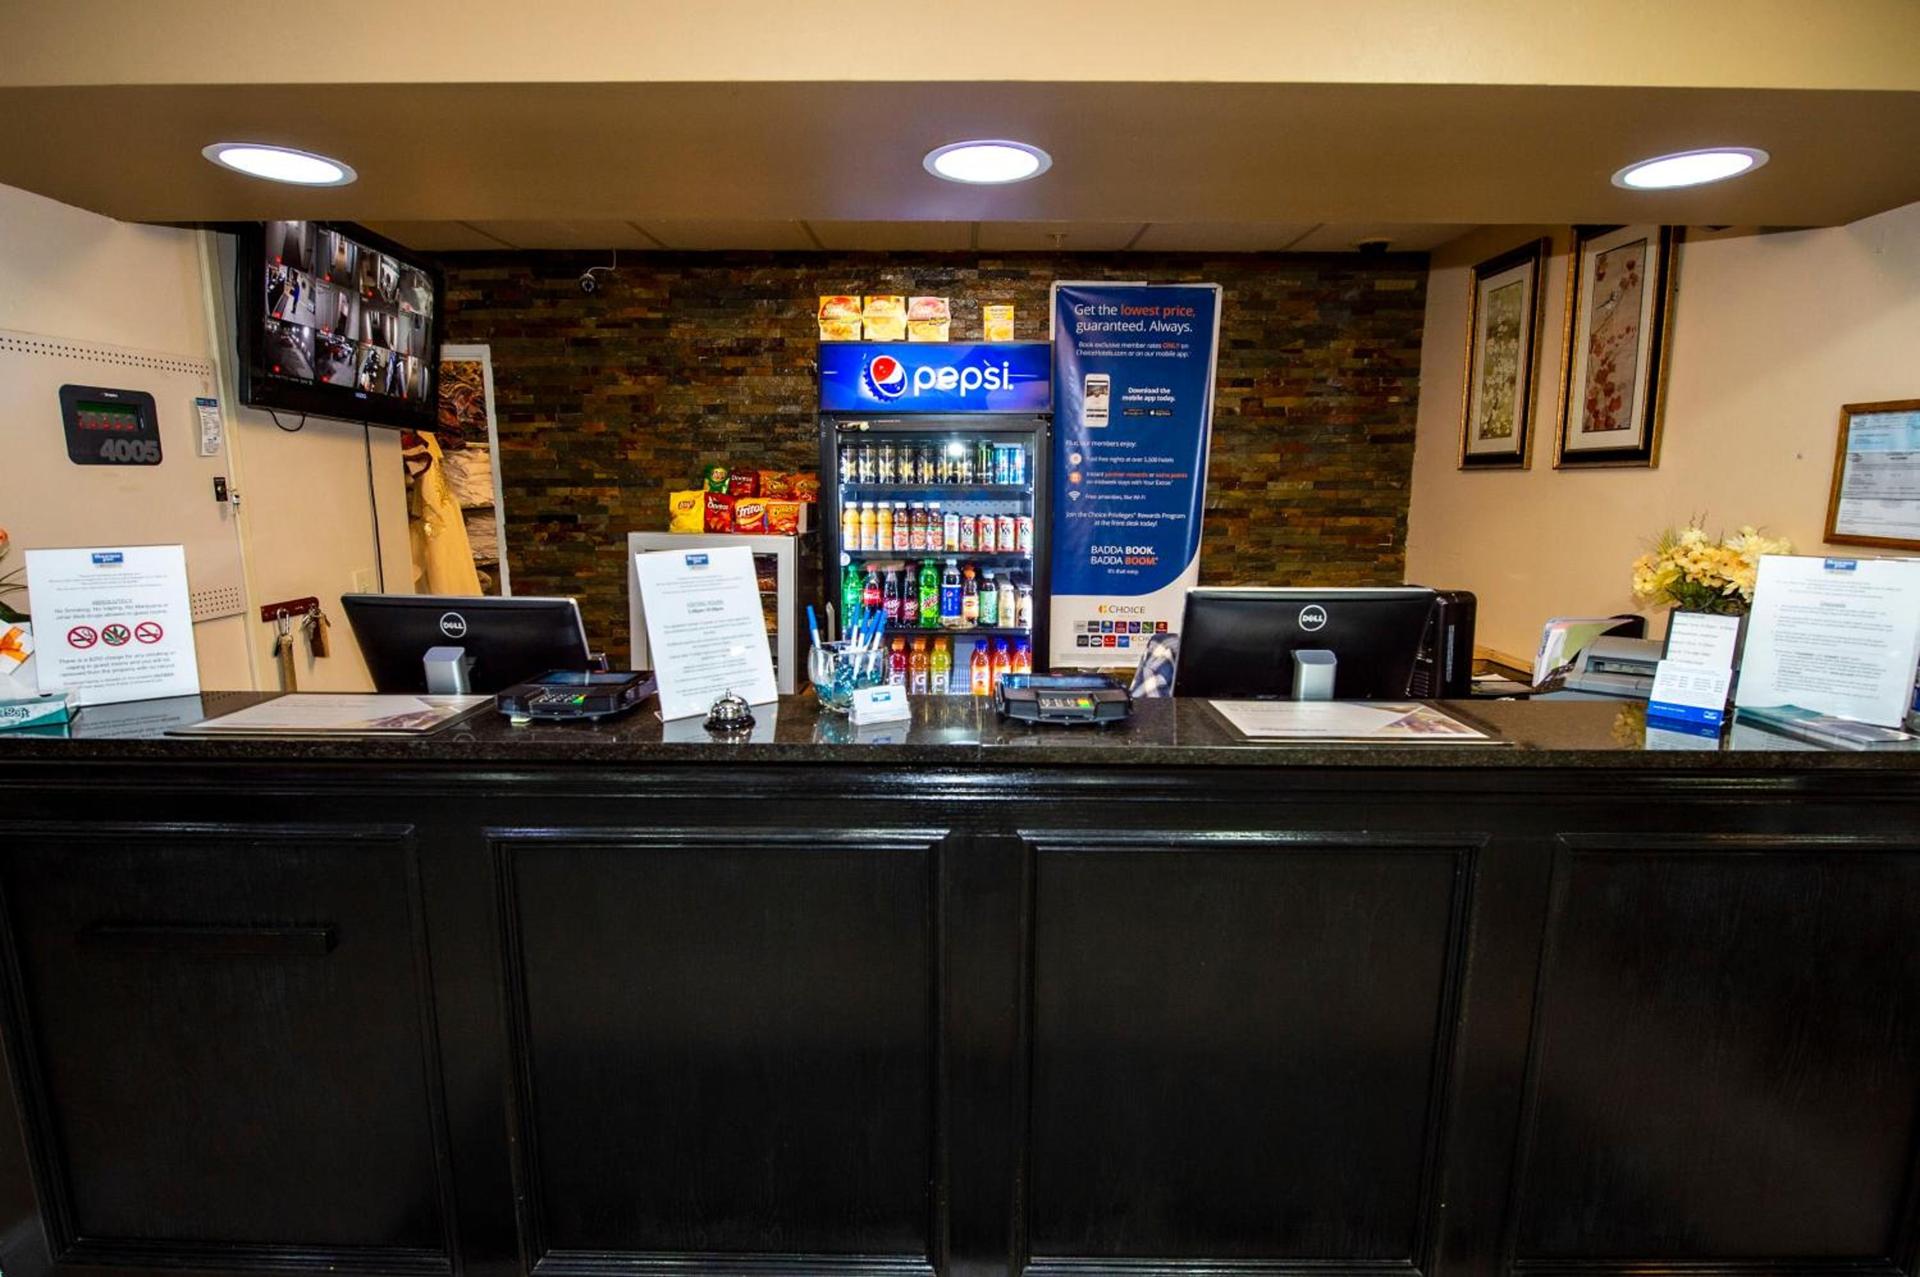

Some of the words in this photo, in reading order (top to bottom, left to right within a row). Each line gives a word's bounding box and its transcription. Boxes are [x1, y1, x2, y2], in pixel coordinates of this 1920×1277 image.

[1074, 304, 1096, 316] Get
[1098, 304, 1118, 316] the
[1120, 304, 1160, 316] lowest
[1075, 320, 1147, 334] guaranteed.
[1149, 321, 1193, 335] Always.
[1121, 341, 1146, 349] member
[1155, 350, 1176, 358] mobile
[1128, 386, 1159, 394] Download
[101, 438, 160, 462] 4005
[1162, 512, 1186, 520] Program
[1090, 546, 1123, 555] BADDA
[1125, 546, 1156, 555] BOOK.
[1090, 556, 1123, 565] BADDA
[1108, 605, 1146, 614] CHOICE
[1302, 614, 1324, 622] DELL
[443, 621, 465, 629] DELL
